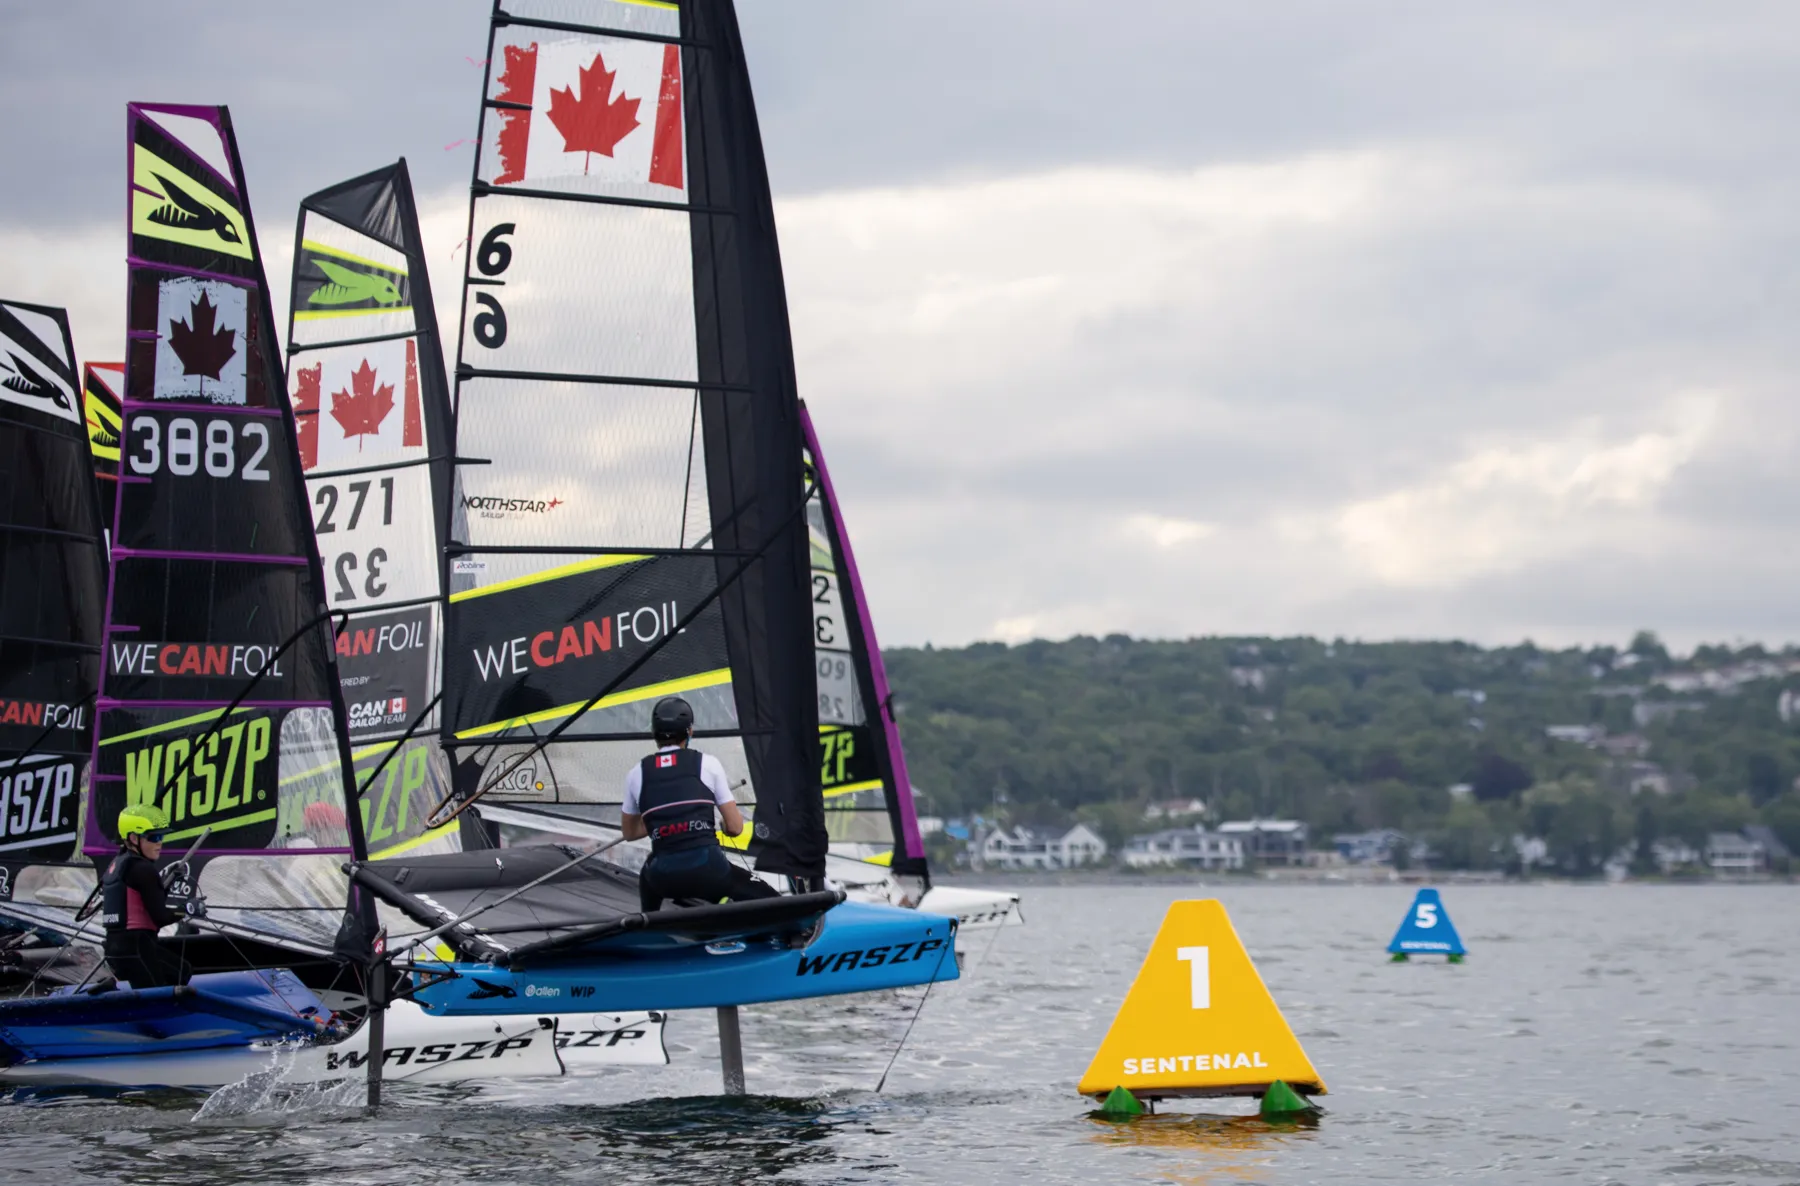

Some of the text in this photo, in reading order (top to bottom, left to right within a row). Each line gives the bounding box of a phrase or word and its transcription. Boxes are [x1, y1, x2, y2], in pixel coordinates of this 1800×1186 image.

[477, 223, 516, 276] 6
[315, 477, 394, 534] 271
[461, 495, 546, 513] NORTHSTAR
[0, 701, 86, 730] ANFOIL
[348, 713, 407, 729] SAILGP TEAM
[349, 700, 387, 719] CAN
[125, 716, 272, 824] WASZP
[1415, 903, 1438, 928] 5
[796, 939, 944, 976] WASZP
[570, 986, 596, 998] WIP
[1177, 946, 1210, 1010] 1
[327, 1037, 534, 1071] WASZP
[1123, 1052, 1268, 1075] SENTENAL
